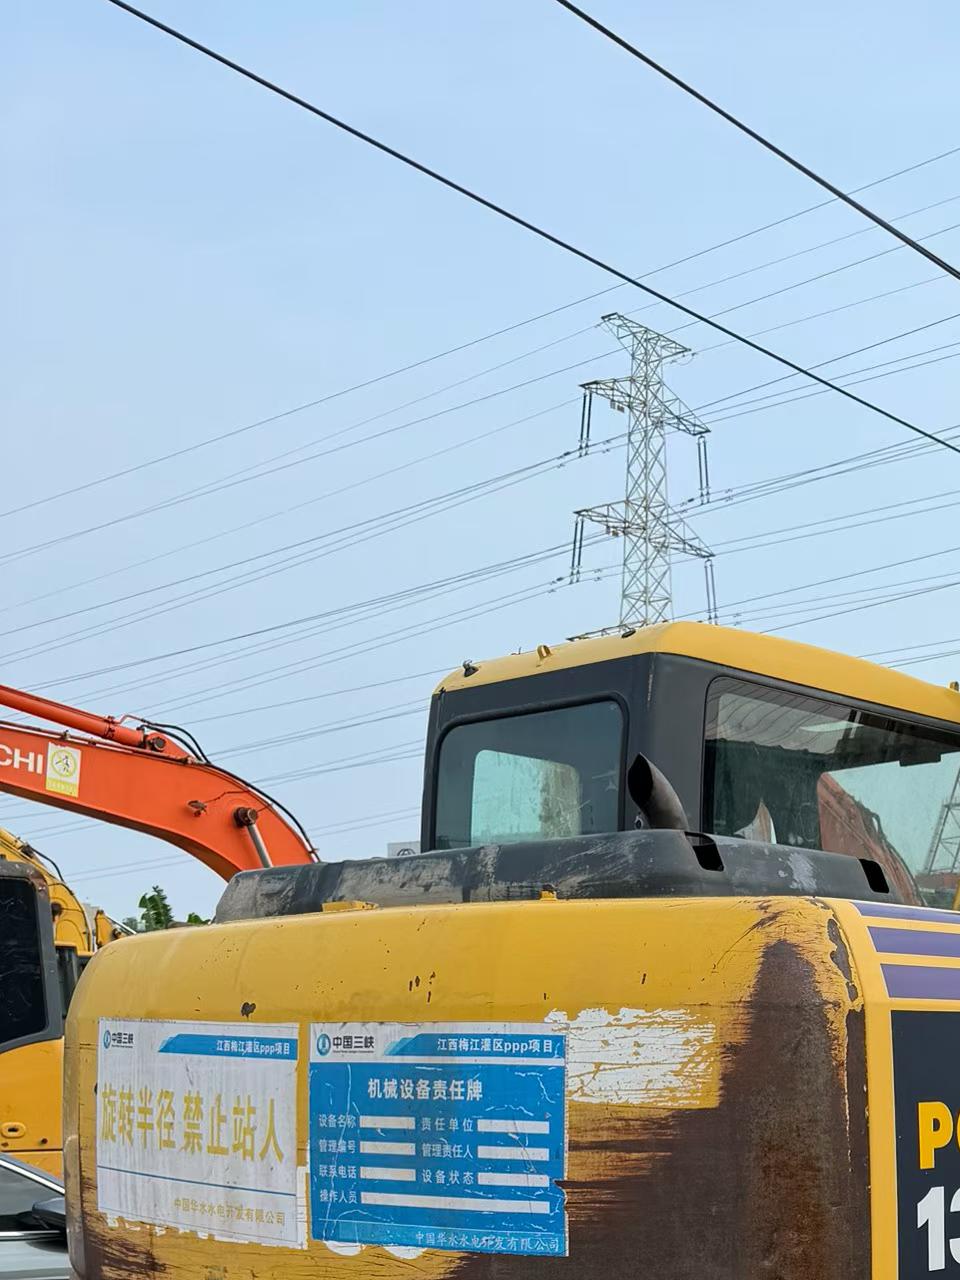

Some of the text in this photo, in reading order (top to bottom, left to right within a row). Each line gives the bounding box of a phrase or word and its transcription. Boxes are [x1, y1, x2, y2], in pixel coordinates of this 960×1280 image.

[332, 1035, 375, 1050] 中国三峡
[437, 1038, 553, 1054] 江西梅江灌区ppp项目
[367, 1078, 484, 1102] 机械设备责任牌
[101, 1084, 284, 1163] 旋转半径 禁止站人
[318, 1113, 357, 1129] 设备名称
[421, 1116, 474, 1132] 责任单位
[318, 1139, 356, 1154] 管理编号
[421, 1143, 474, 1159] 管理责任人
[319, 1165, 357, 1179] 联系电话
[421, 1169, 474, 1185] 设备状态
[319, 1189, 358, 1204] 操作人员
